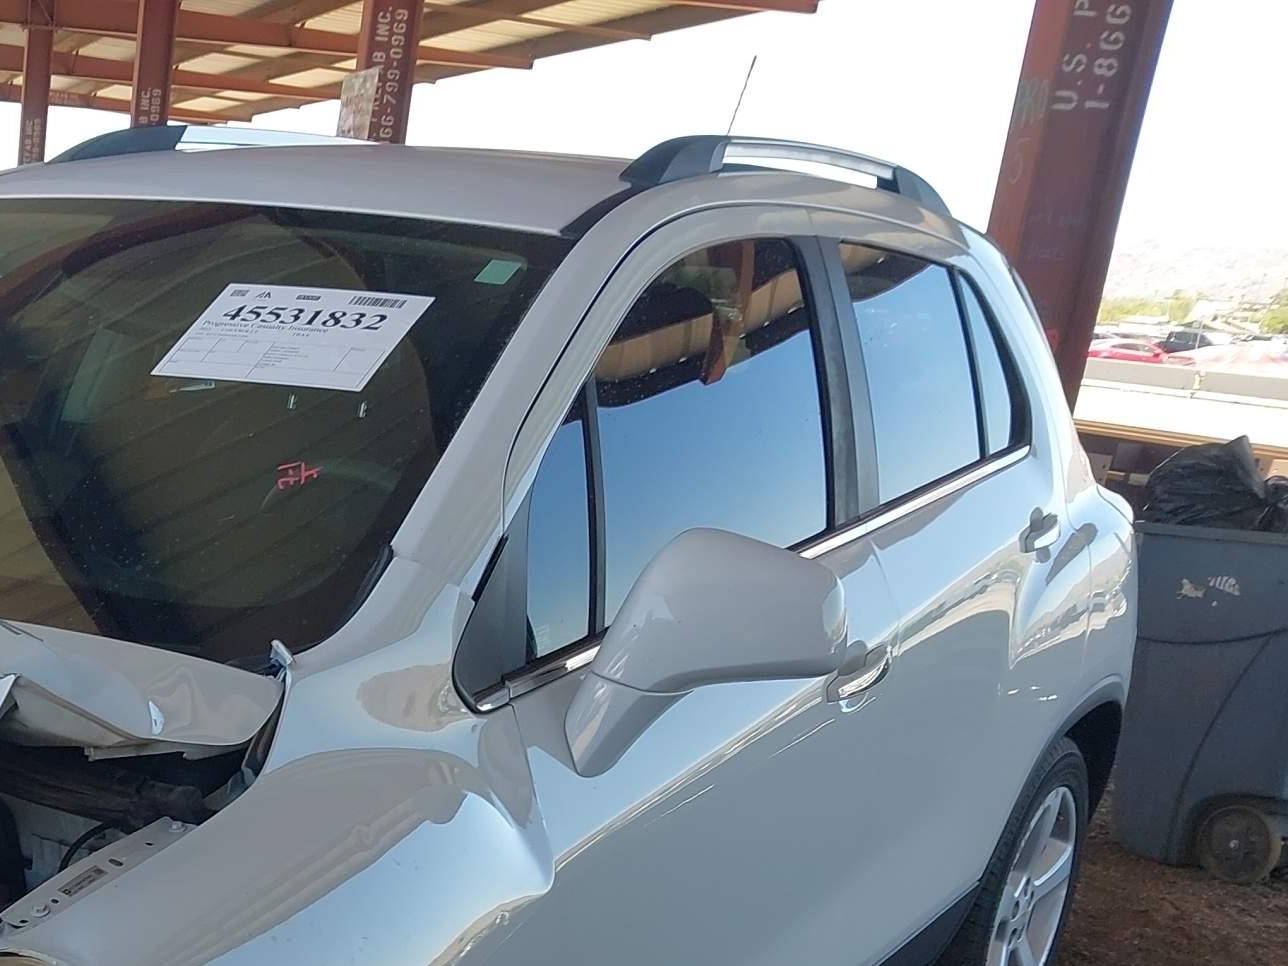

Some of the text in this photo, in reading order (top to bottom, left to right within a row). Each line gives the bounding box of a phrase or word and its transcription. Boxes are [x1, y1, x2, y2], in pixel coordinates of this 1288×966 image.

[374, 6, 393, 42] INC.
[1051, 43, 1092, 111] U.S.
[222, 304, 388, 331] 45531832
